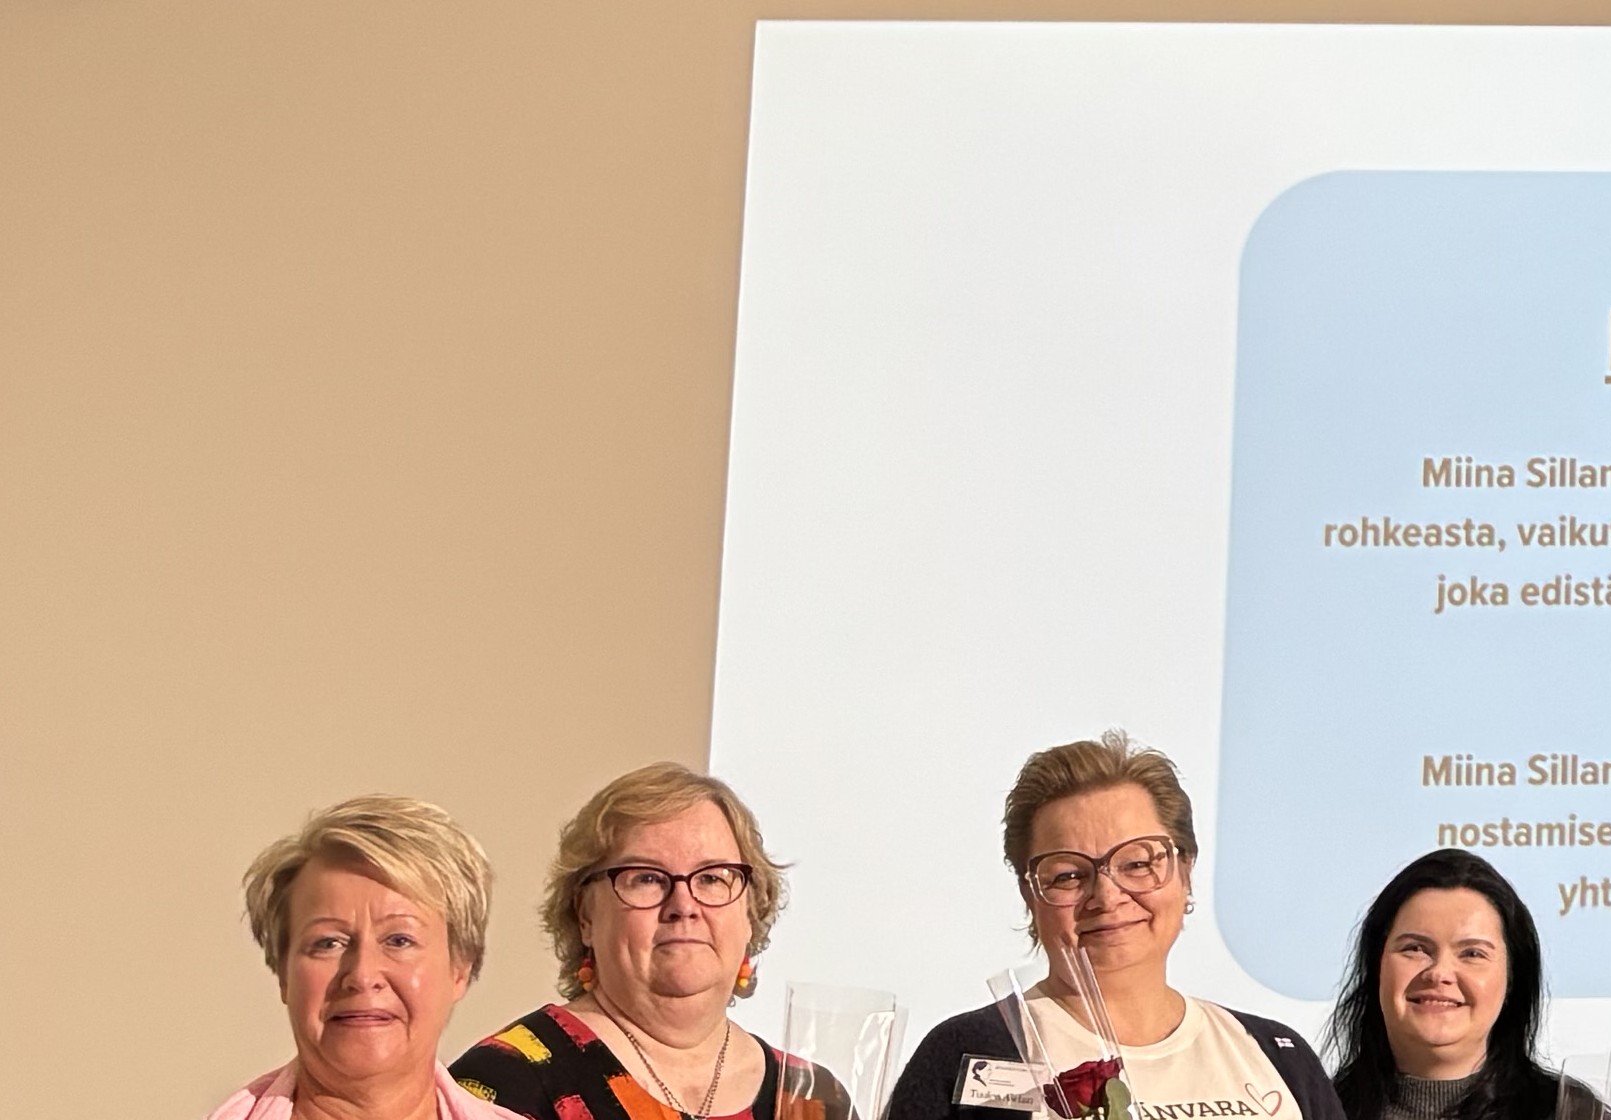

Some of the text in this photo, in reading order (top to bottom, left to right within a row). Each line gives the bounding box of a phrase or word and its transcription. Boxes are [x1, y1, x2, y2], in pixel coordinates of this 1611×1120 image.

[1422, 455, 1515, 488] Miina
[1322, 516, 1505, 553] rohkeasta,
[1434, 575, 1510, 614] joka
[1421, 754, 1516, 787] Miina
